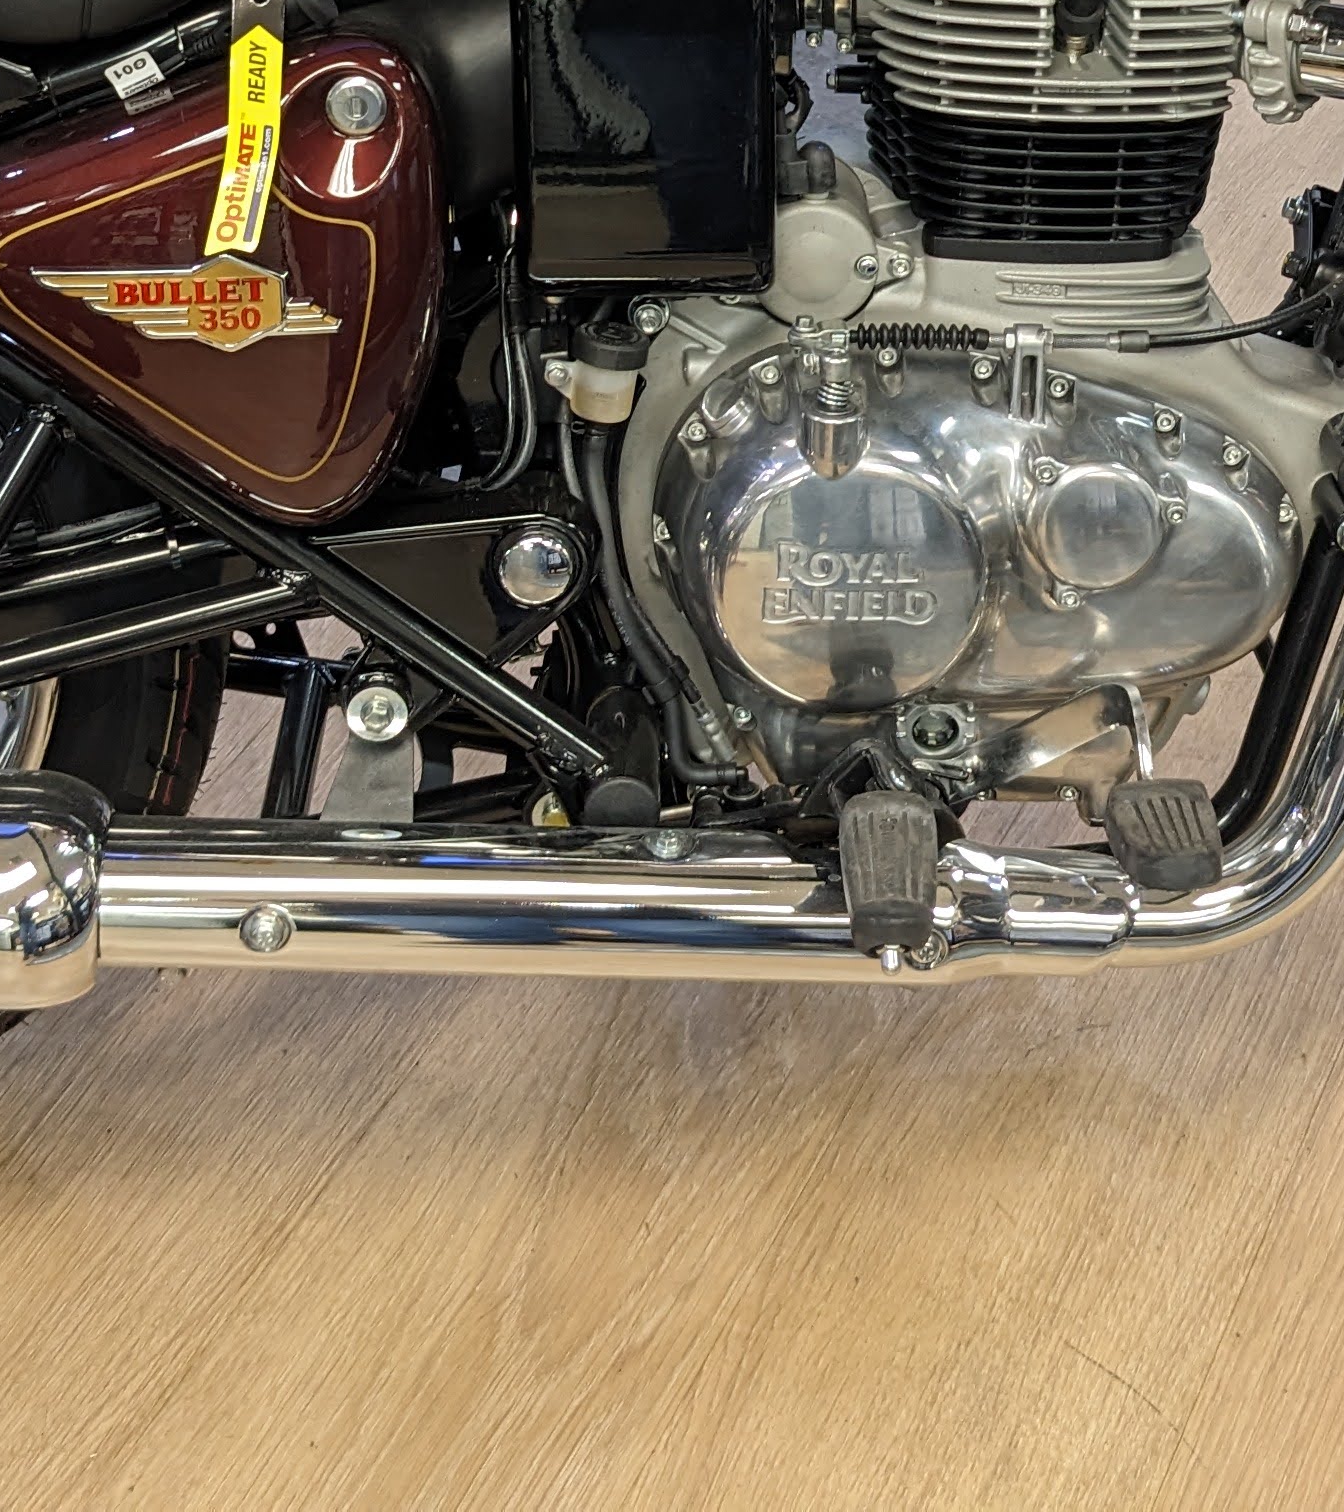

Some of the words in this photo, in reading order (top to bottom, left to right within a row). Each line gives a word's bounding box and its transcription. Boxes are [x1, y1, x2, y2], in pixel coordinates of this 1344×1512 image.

[216, 122, 257, 242] OptiMATE
[248, 40, 268, 104] READY
[113, 278, 268, 305] BULLET
[198, 305, 261, 331] 350
[776, 541, 924, 587] ROYAL
[762, 587, 938, 625] ENFIELD
